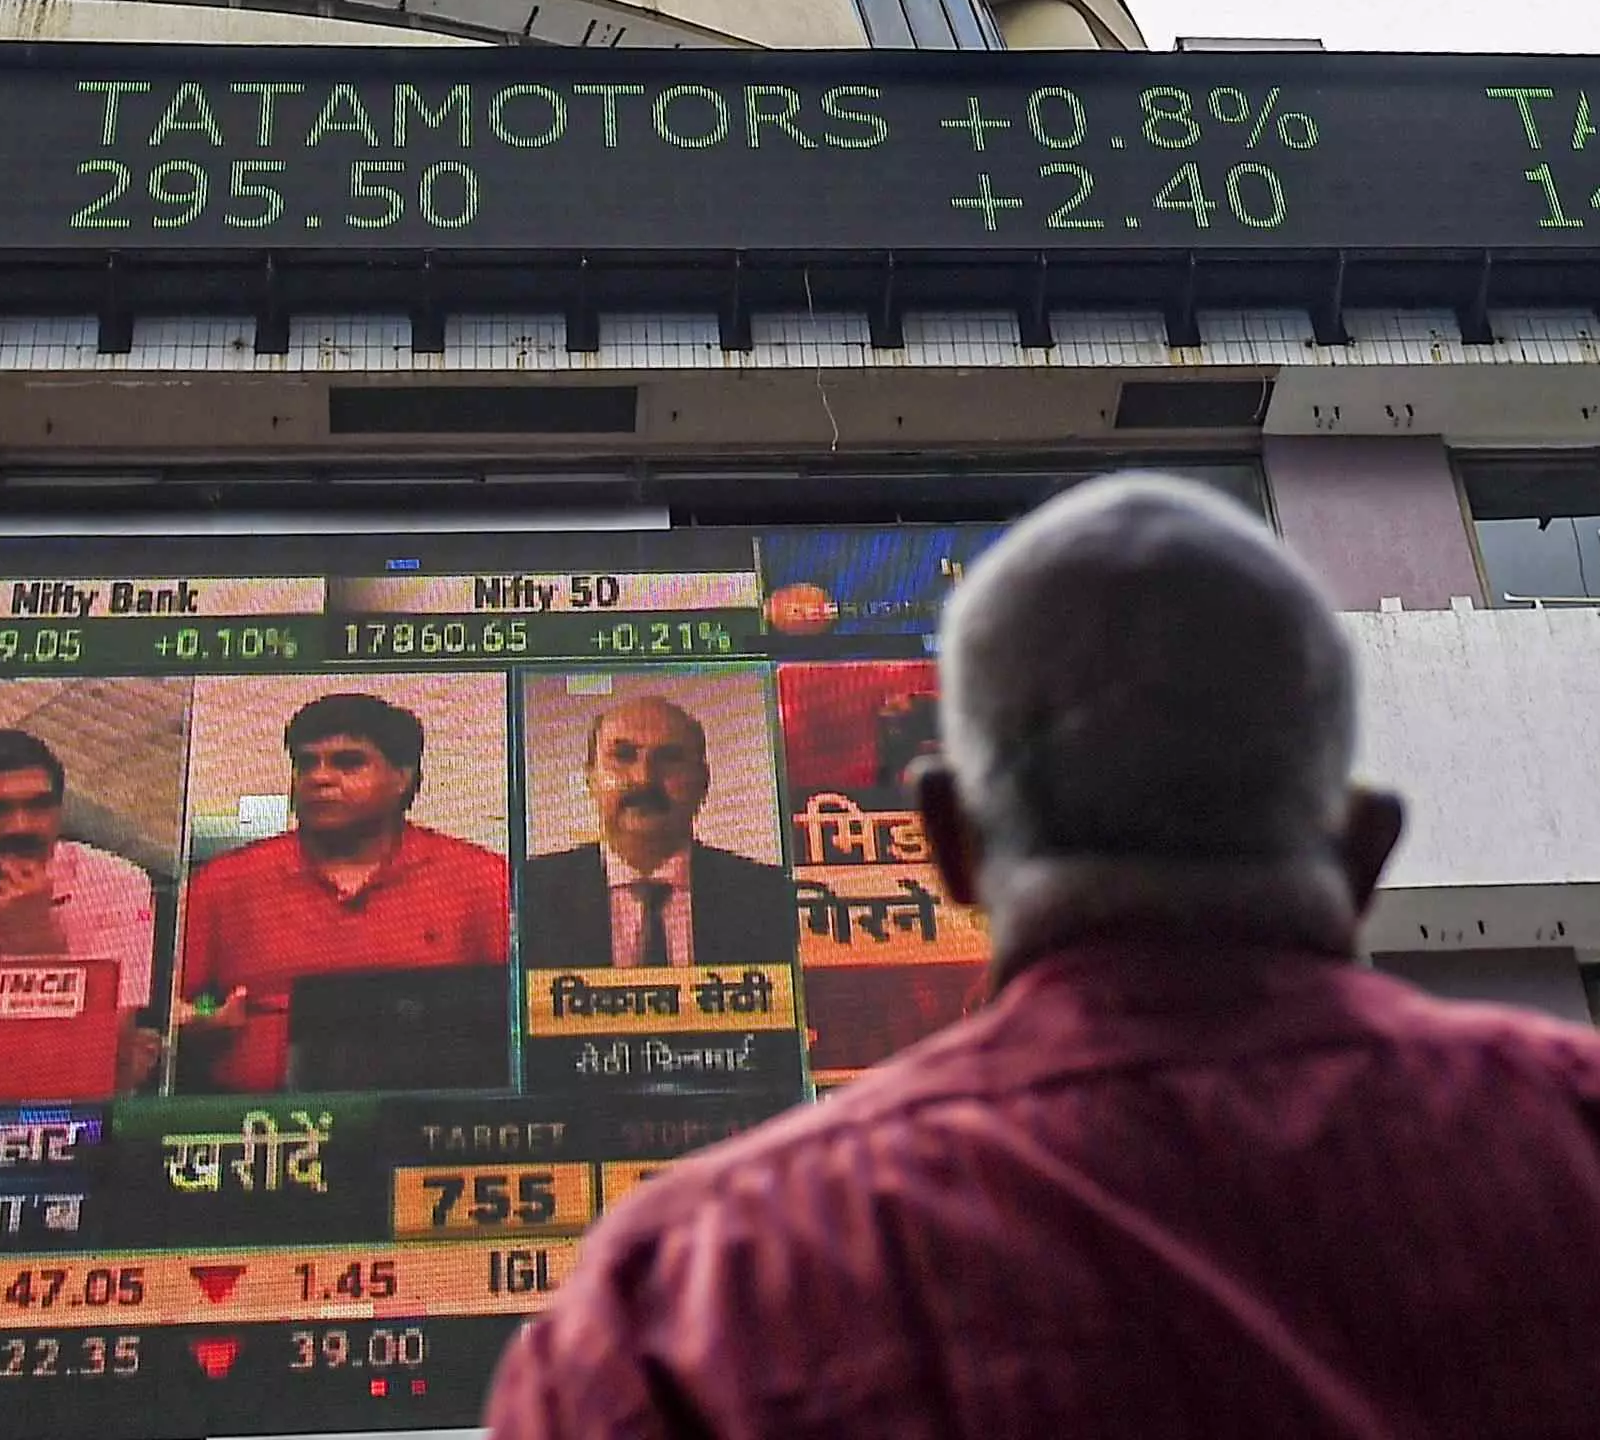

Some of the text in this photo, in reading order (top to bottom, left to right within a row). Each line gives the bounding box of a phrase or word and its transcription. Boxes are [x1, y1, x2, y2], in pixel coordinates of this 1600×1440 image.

[75, 81, 1322, 152] TATAMOTORS +0.8%
[68, 160, 1290, 231] 295.50 +2.40
[10, 580, 199, 616] Nifty Bank
[474, 575, 557, 612] Nifty
[154, 629, 297, 657] +0.10%
[343, 622, 732, 654] 17860.65 +0.21%
[162, 1110, 334, 1193] खरीदें
[423, 1122, 568, 1152] TARGET
[423, 1176, 556, 1226] 755
[6, 1267, 144, 1308] 47.05
[294, 1261, 398, 1301] 1.45
[289, 1328, 426, 1368] 39.00
